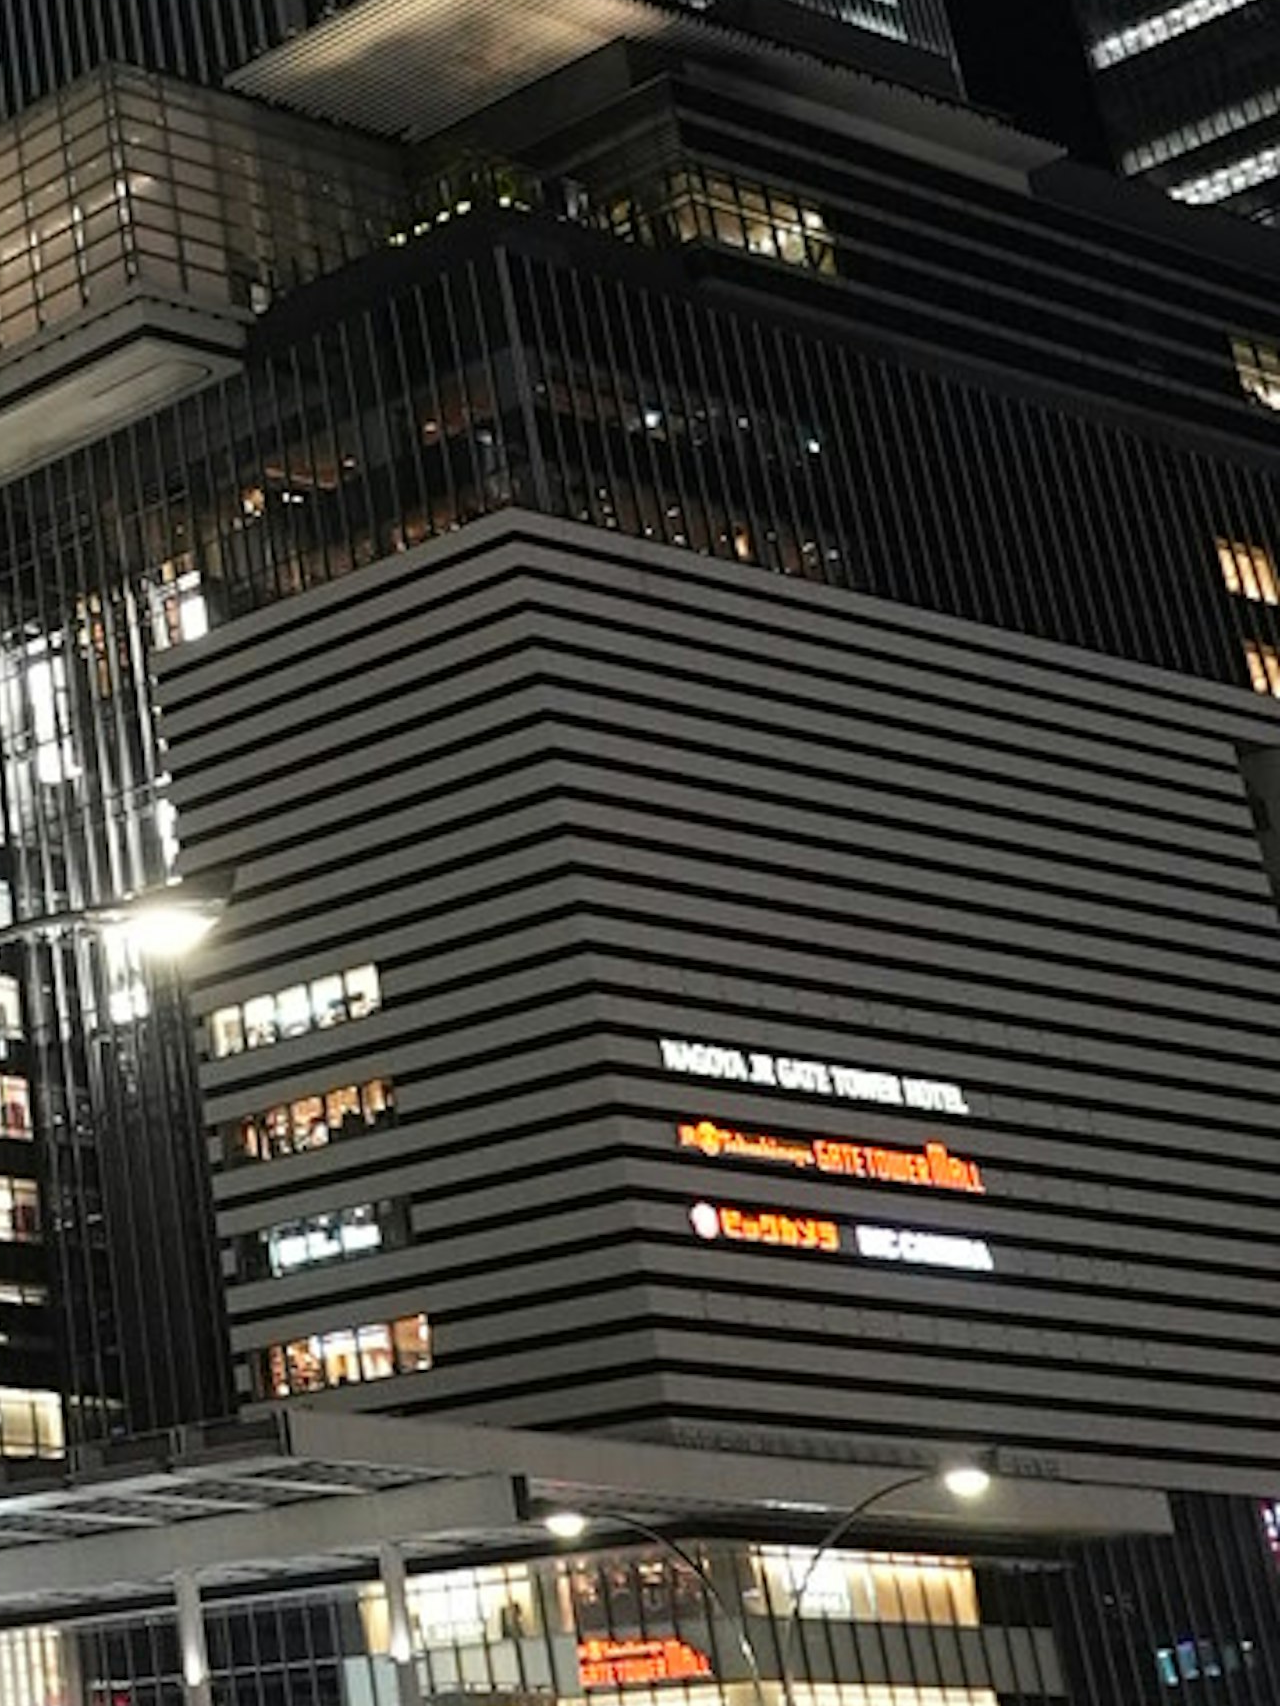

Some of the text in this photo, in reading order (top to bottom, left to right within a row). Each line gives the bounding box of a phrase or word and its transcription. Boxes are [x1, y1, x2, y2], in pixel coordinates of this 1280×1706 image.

[660, 1039, 748, 1081] NAGOYA
[776, 1057, 831, 1093] GATE
[830, 1064, 903, 1104] TOWER
